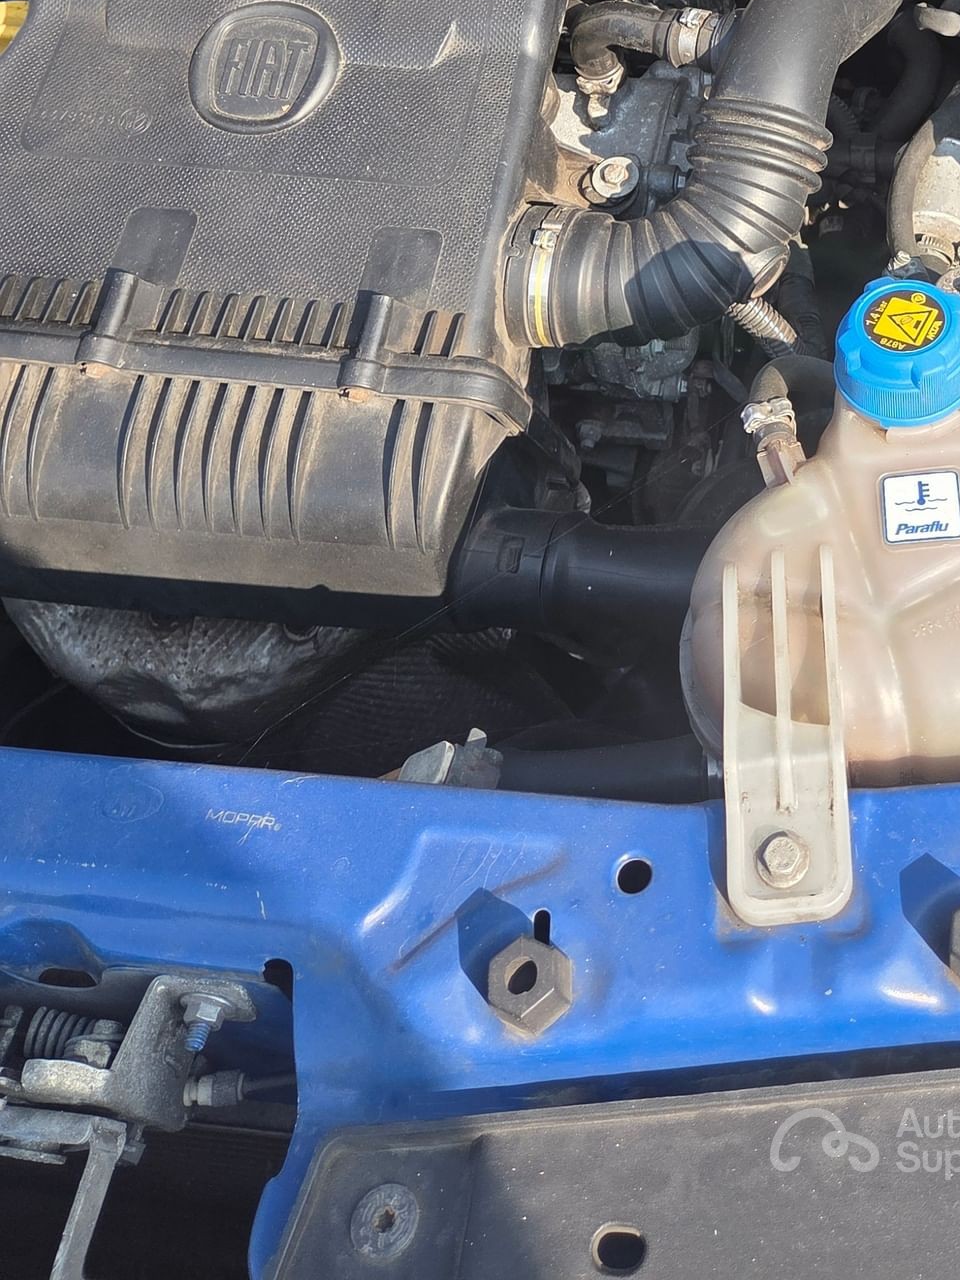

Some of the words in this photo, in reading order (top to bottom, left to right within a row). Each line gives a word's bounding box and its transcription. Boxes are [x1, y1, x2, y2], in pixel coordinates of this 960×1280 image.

[218, 38, 311, 100] FIAT
[895, 519, 949, 536] Paraflu
[205, 807, 276, 830] MOPAR
